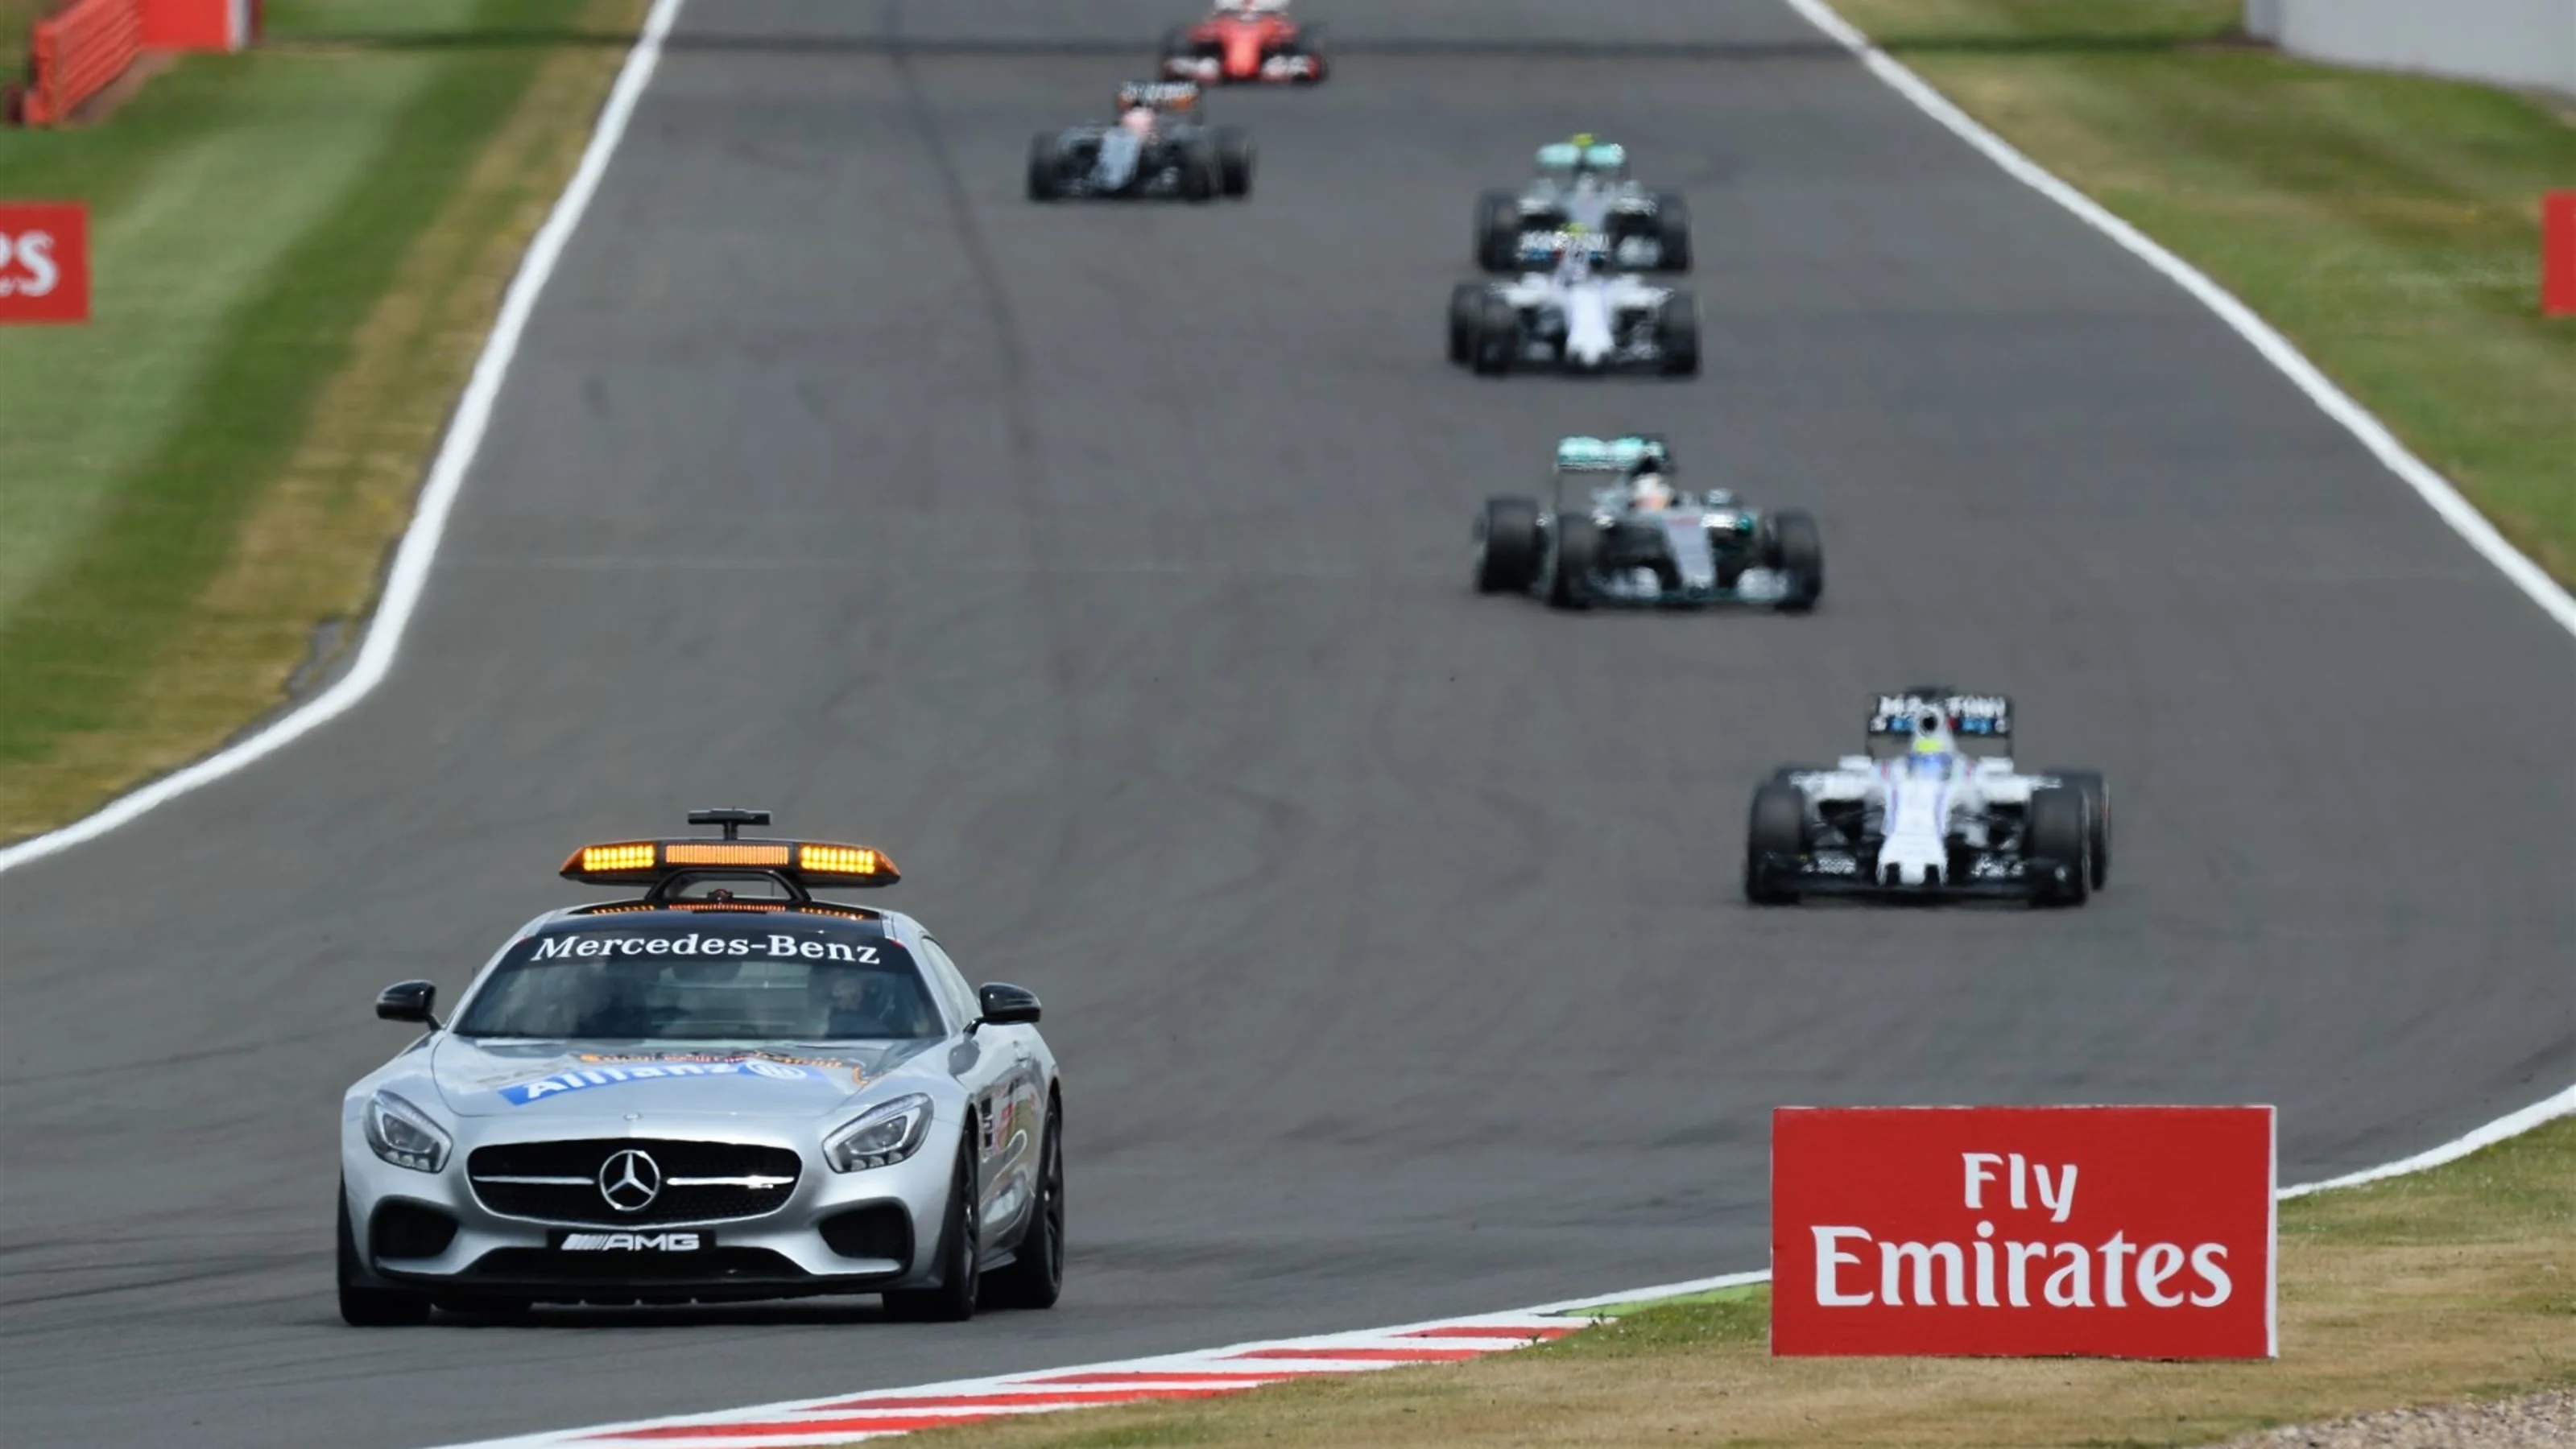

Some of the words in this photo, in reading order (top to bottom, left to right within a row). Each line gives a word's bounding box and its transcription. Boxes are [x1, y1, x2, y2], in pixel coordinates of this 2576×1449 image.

[530, 934, 880, 964] Mercedes-Benz
[526, 1063, 739, 1099] Allianz
[1962, 1152, 2078, 1223] Fly
[602, 1233, 700, 1252] AMG
[1810, 1220, 2232, 1308] Emirates
